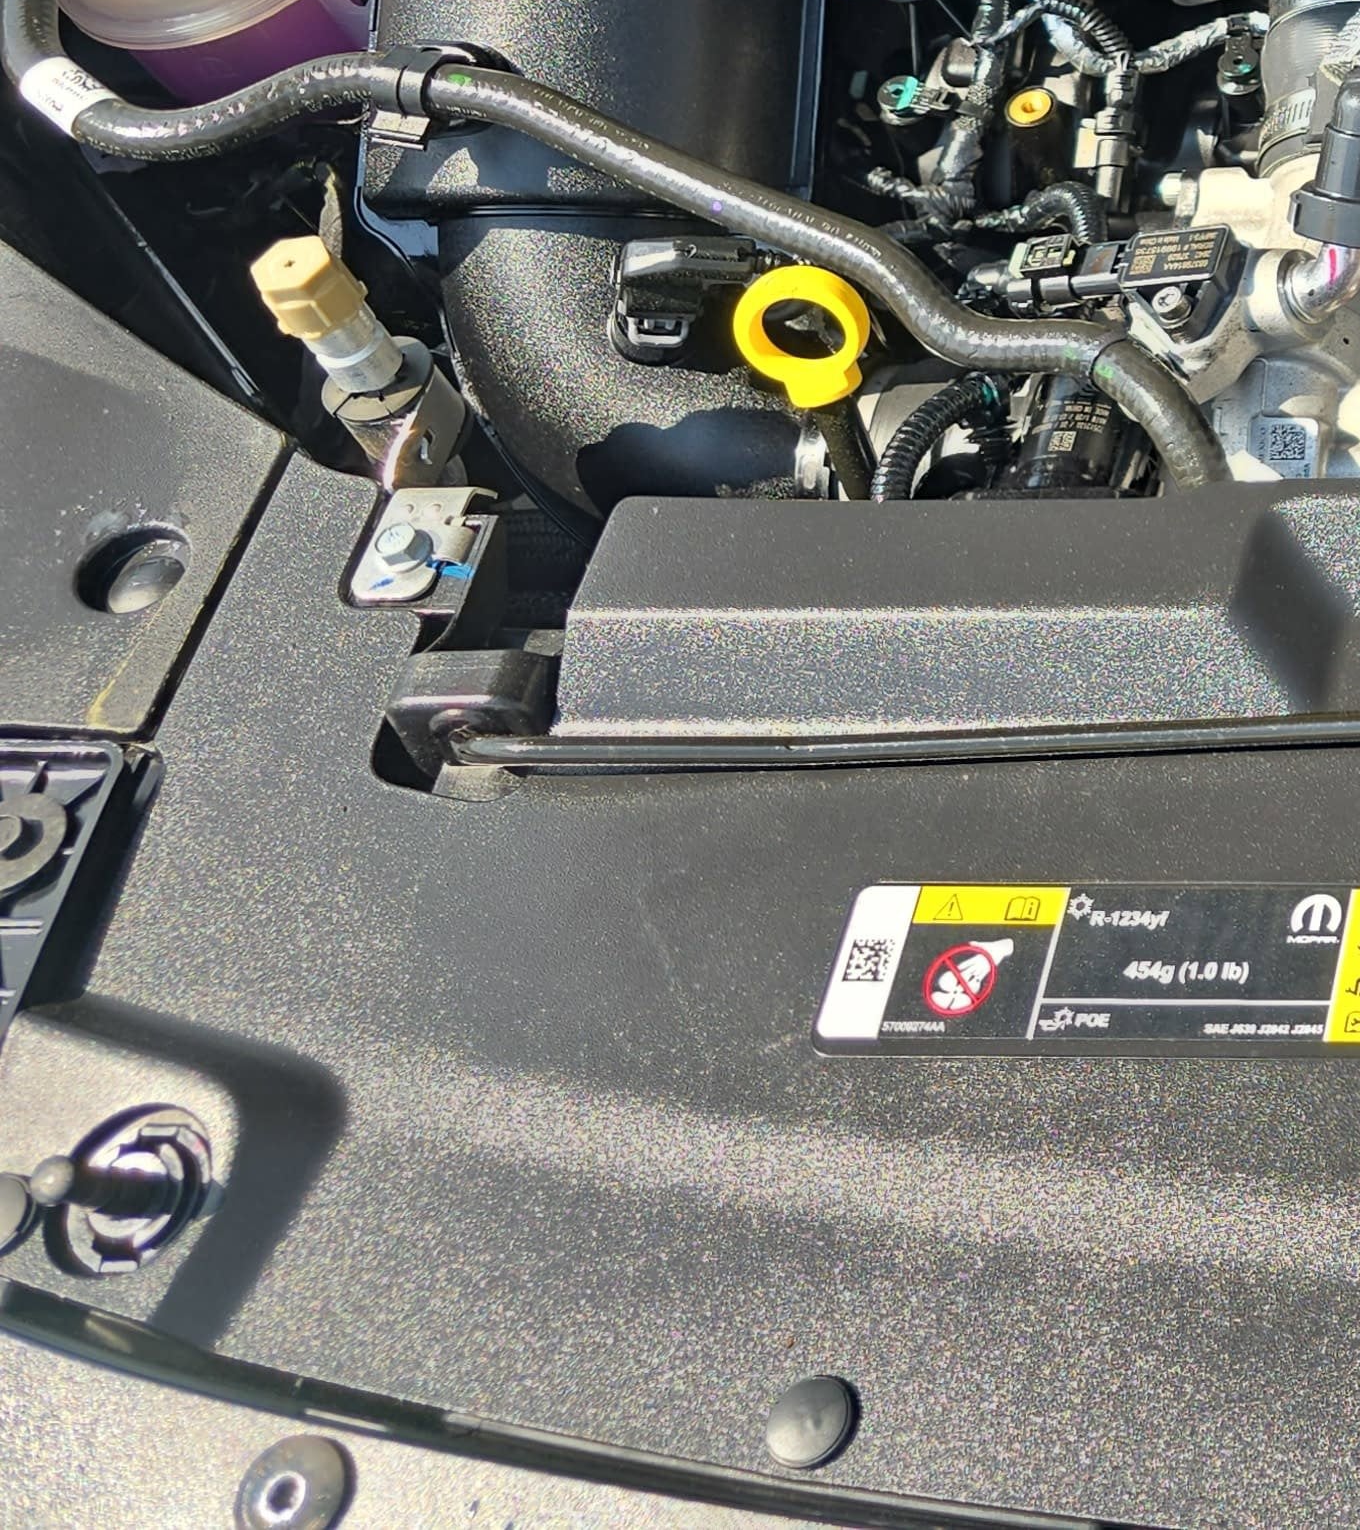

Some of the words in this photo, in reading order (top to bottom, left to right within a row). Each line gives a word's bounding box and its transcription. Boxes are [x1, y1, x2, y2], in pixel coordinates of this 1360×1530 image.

[1089, 910, 1171, 931] R-1234yf
[1286, 934, 1338, 944] MOPAR
[1122, 960, 1176, 985] 454g
[1178, 960, 1219, 985] (1.0
[1221, 960, 1250, 985] lb)
[1074, 1012, 1111, 1028] POE
